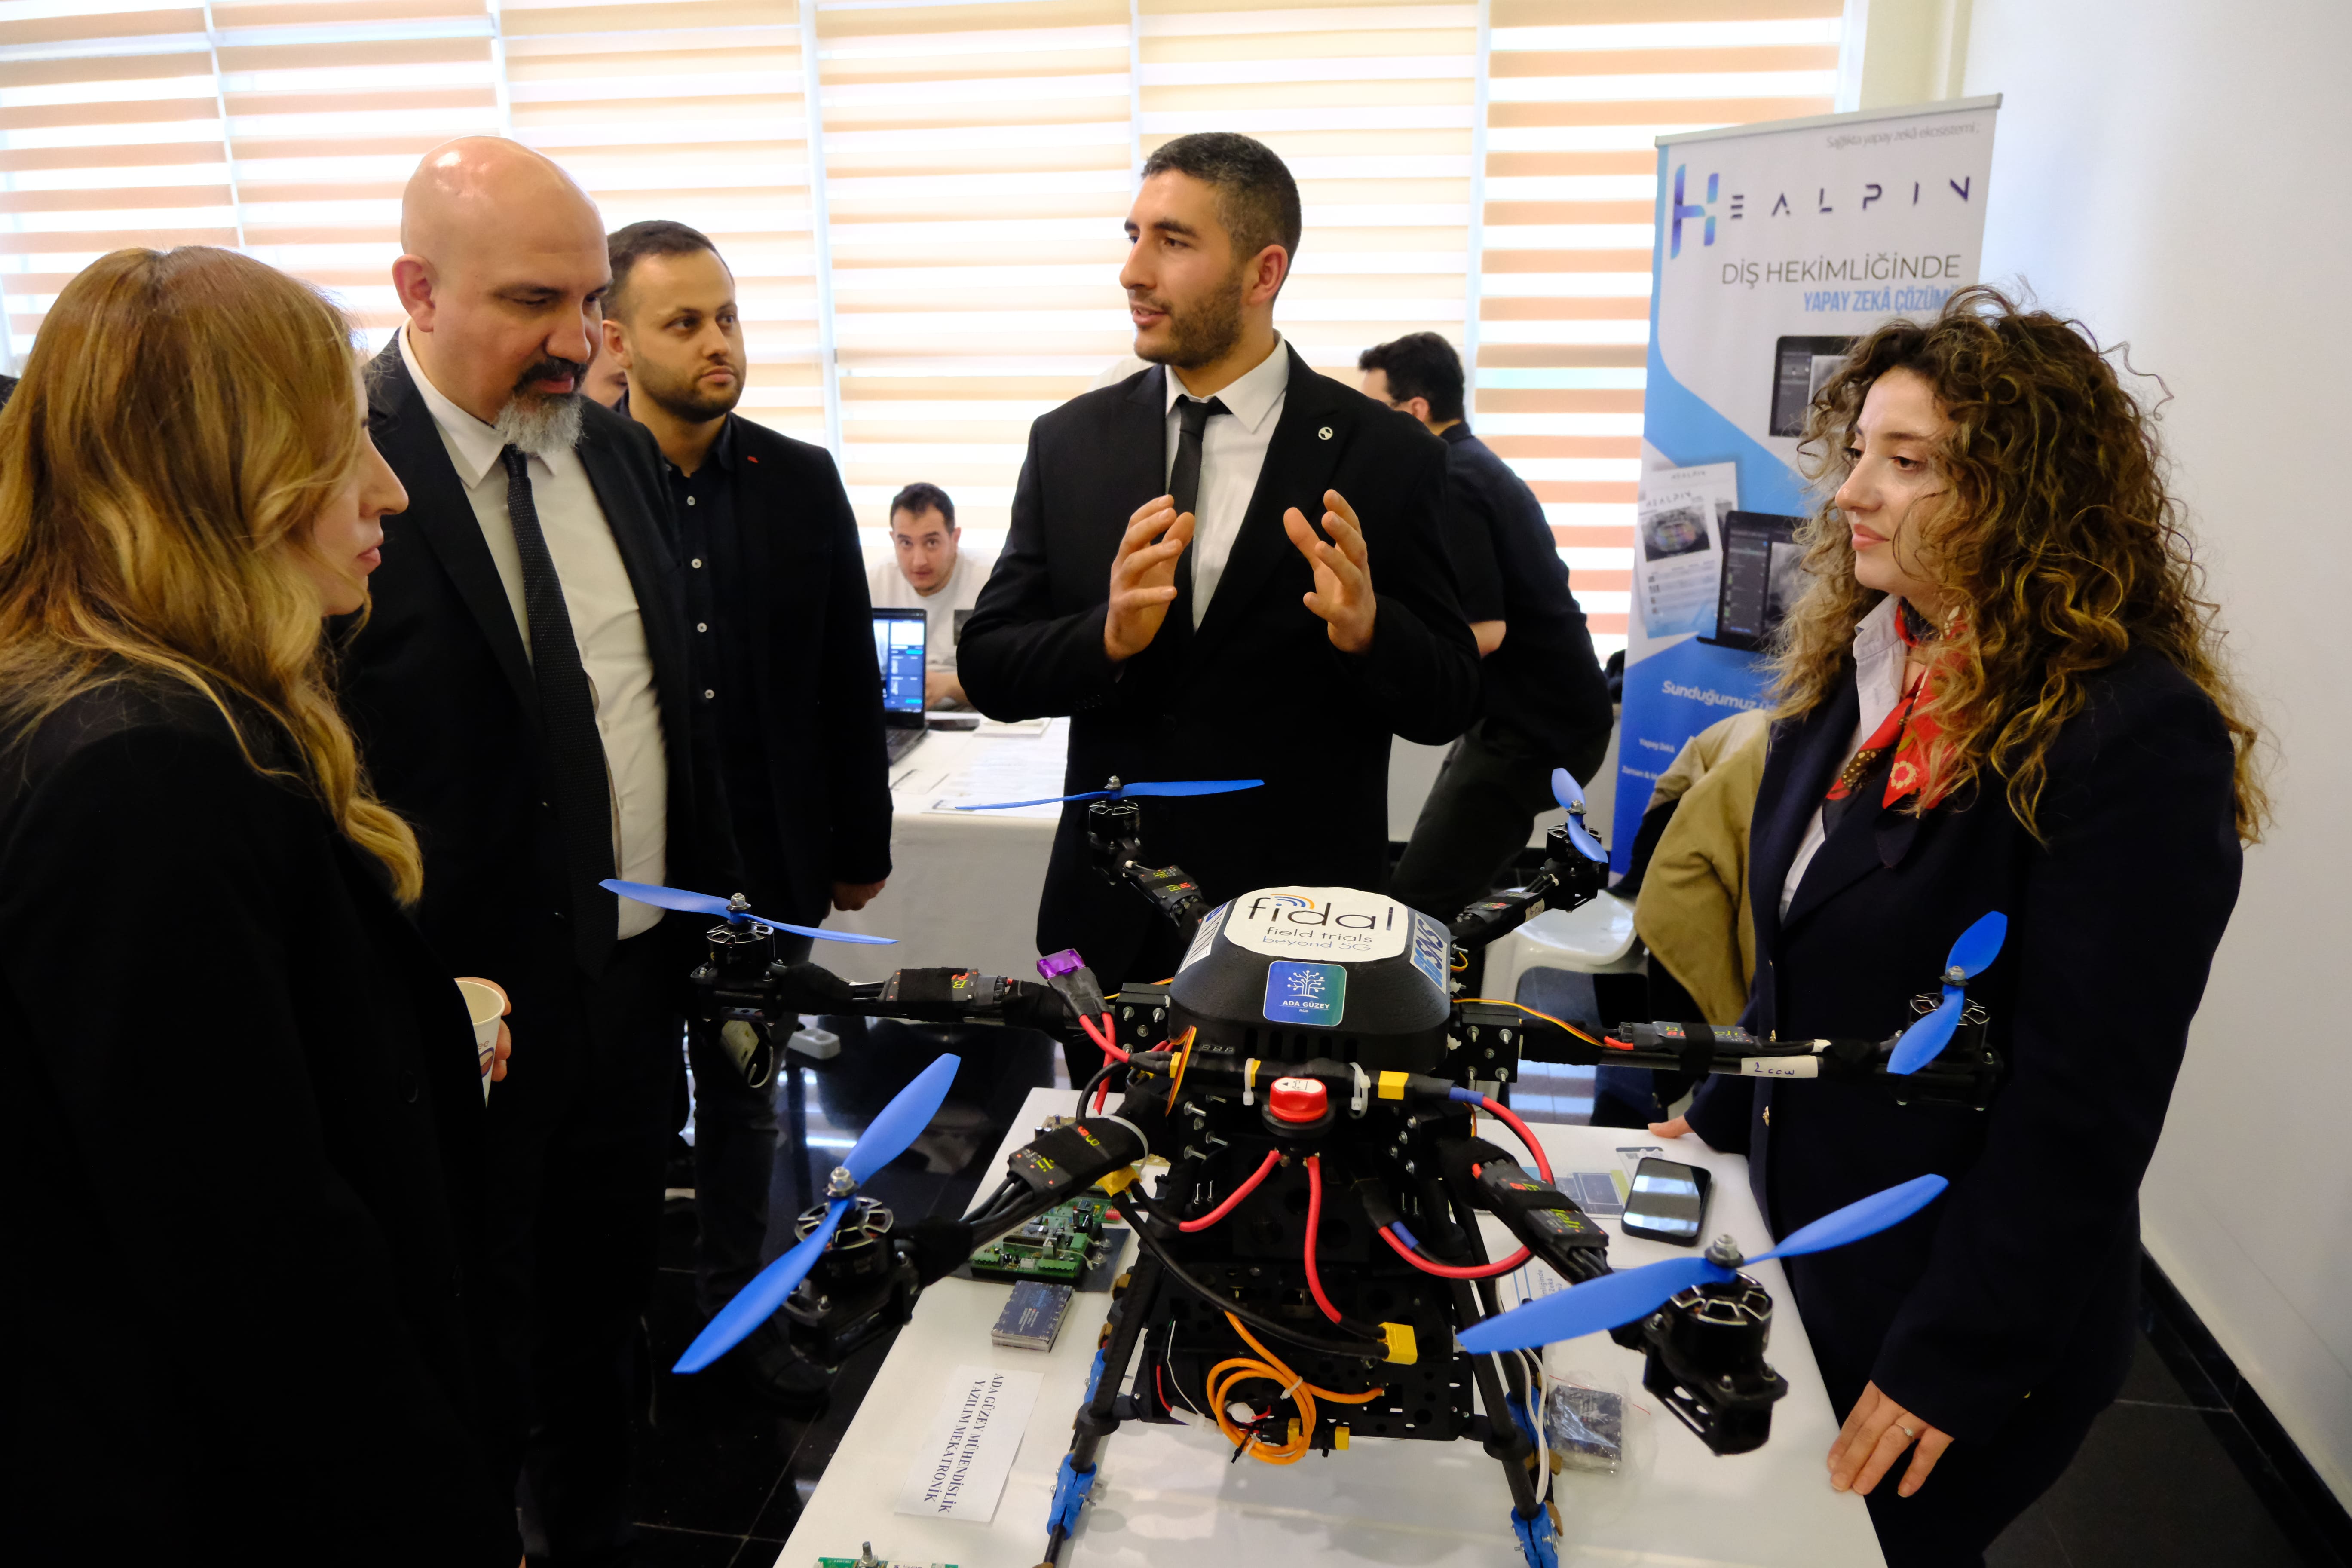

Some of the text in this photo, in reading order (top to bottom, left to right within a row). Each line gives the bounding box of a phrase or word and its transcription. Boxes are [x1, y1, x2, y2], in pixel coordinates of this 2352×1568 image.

[1722, 253, 1961, 289] DİŞ HEKİMLİĞİNDE
[1804, 285, 1957, 315] YAPAY ZEKÂ ÇÖZÜM
[1662, 680, 1757, 712] Sunduğumuz
[1248, 897, 1394, 931] fidal
[1262, 935, 1371, 951] beyond 5G
[1267, 926, 1372, 943] field trials
[1302, 1001, 1330, 1009] GÜZEY
[924, 1380, 986, 1502] YAZILIM MEKATRONİK
[938, 1373, 1004, 1513] ADA GÜZEY MÜHENDİSLİK
